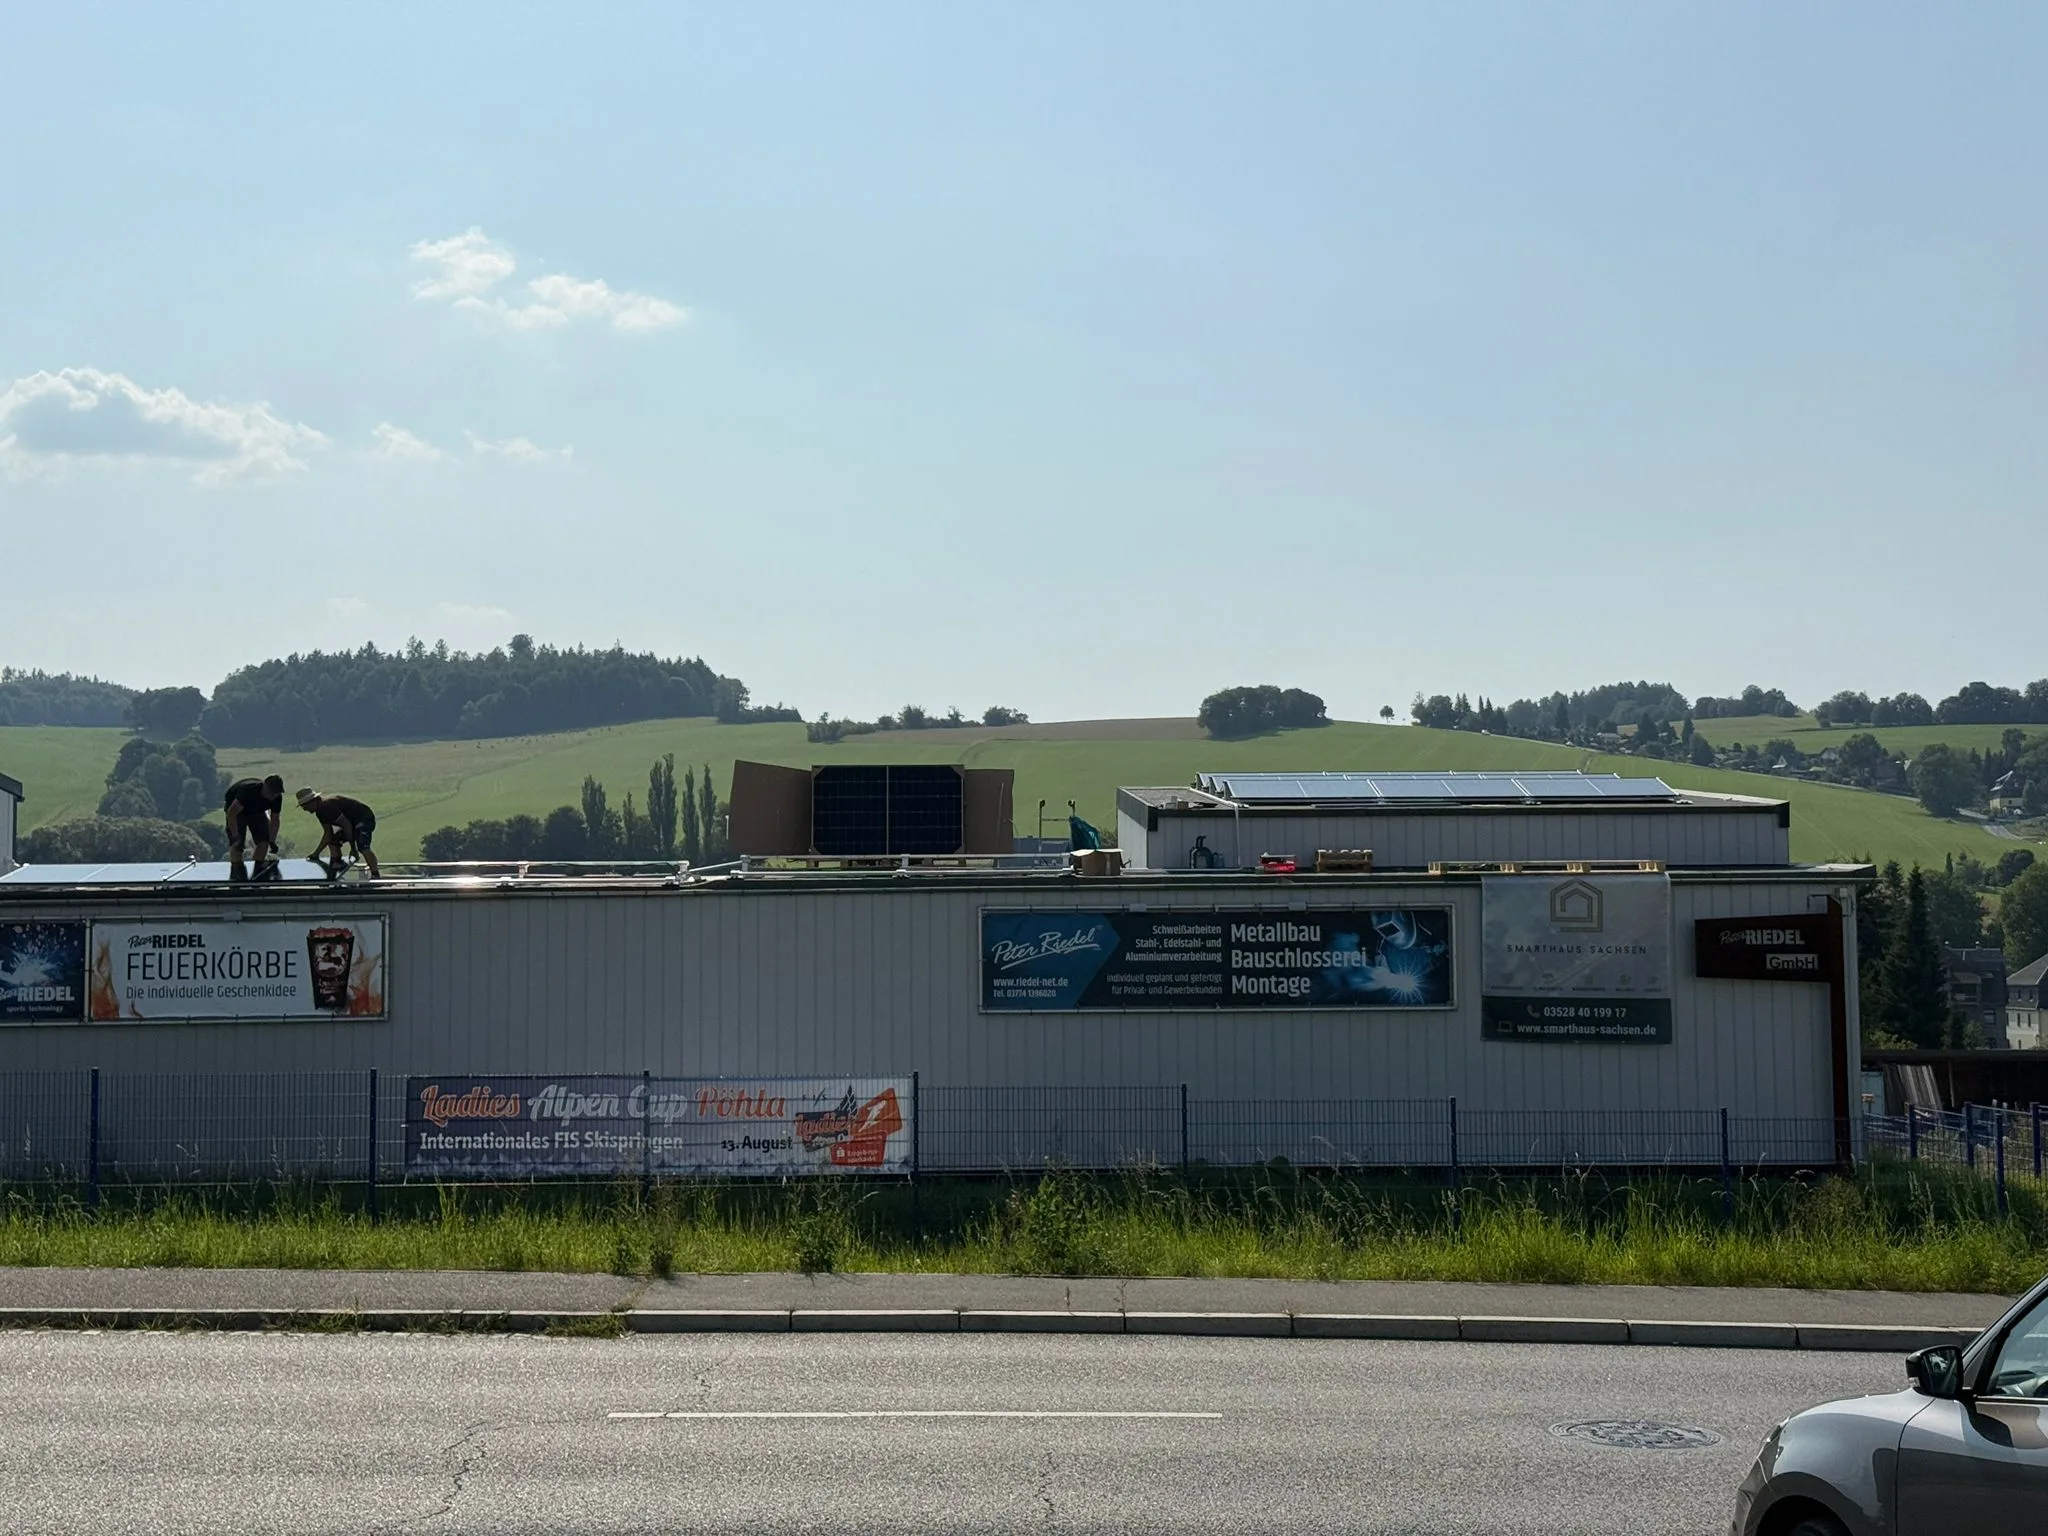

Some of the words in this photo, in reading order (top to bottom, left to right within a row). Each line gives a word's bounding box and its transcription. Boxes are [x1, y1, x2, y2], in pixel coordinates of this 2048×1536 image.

[1152, 924, 1222, 935] Schweißarbeiten
[1230, 922, 1321, 942] Metallbau
[1745, 929, 1805, 945] RIEDEL
[152, 934, 206, 949] RIEDEL
[991, 940, 1039, 964] Peter
[1038, 928, 1096, 955] Riedel
[1135, 938, 1162, 949] Stahl-,
[1163, 938, 1204, 948] Edelstahl-
[1206, 938, 1222, 948] und
[1125, 951, 1222, 963] Aluminiumverarbeitung
[1506, 944, 1582, 954] SMARTHAUS
[1590, 945, 1647, 955] SACHSEN
[127, 946, 298, 980] FEUERKÖRBE
[1231, 947, 1367, 969] Bauschlosserei
[1769, 956, 1816, 969] GmbH
[992, 976, 1069, 988] www.riedel-net.de
[1106, 973, 1145, 983] individuell
[1145, 974, 1173, 984] geplant
[1174, 973, 1189, 983] und
[1190, 973, 1223, 984] gefertigt
[1232, 974, 1311, 997] Montage
[18, 986, 75, 1002] RIEDEL
[126, 985, 144, 999] Die
[217, 983, 296, 998] Geschenkidee
[1111, 985, 1122, 995] für
[1148, 985, 1163, 995] und
[1163, 985, 1223, 995] Gewerbekunden
[1543, 1006, 1575, 1017] 03528
[1578, 1006, 1590, 1017] 40
[1594, 1006, 1612, 1018] 199
[1615, 1007, 1627, 1018] 17
[1517, 1023, 1657, 1035] www.smarthaus-sachsen.de
[420, 1085, 521, 1127] Ladies
[527, 1084, 620, 1127] Alpen
[627, 1084, 688, 1127] Cup
[695, 1086, 786, 1118] Pöhla
[420, 1131, 550, 1150] Internationales
[554, 1131, 580, 1148] FIS
[583, 1130, 684, 1153] Skispringen
[721, 1139, 740, 1152] 13.
[742, 1136, 793, 1152] August
